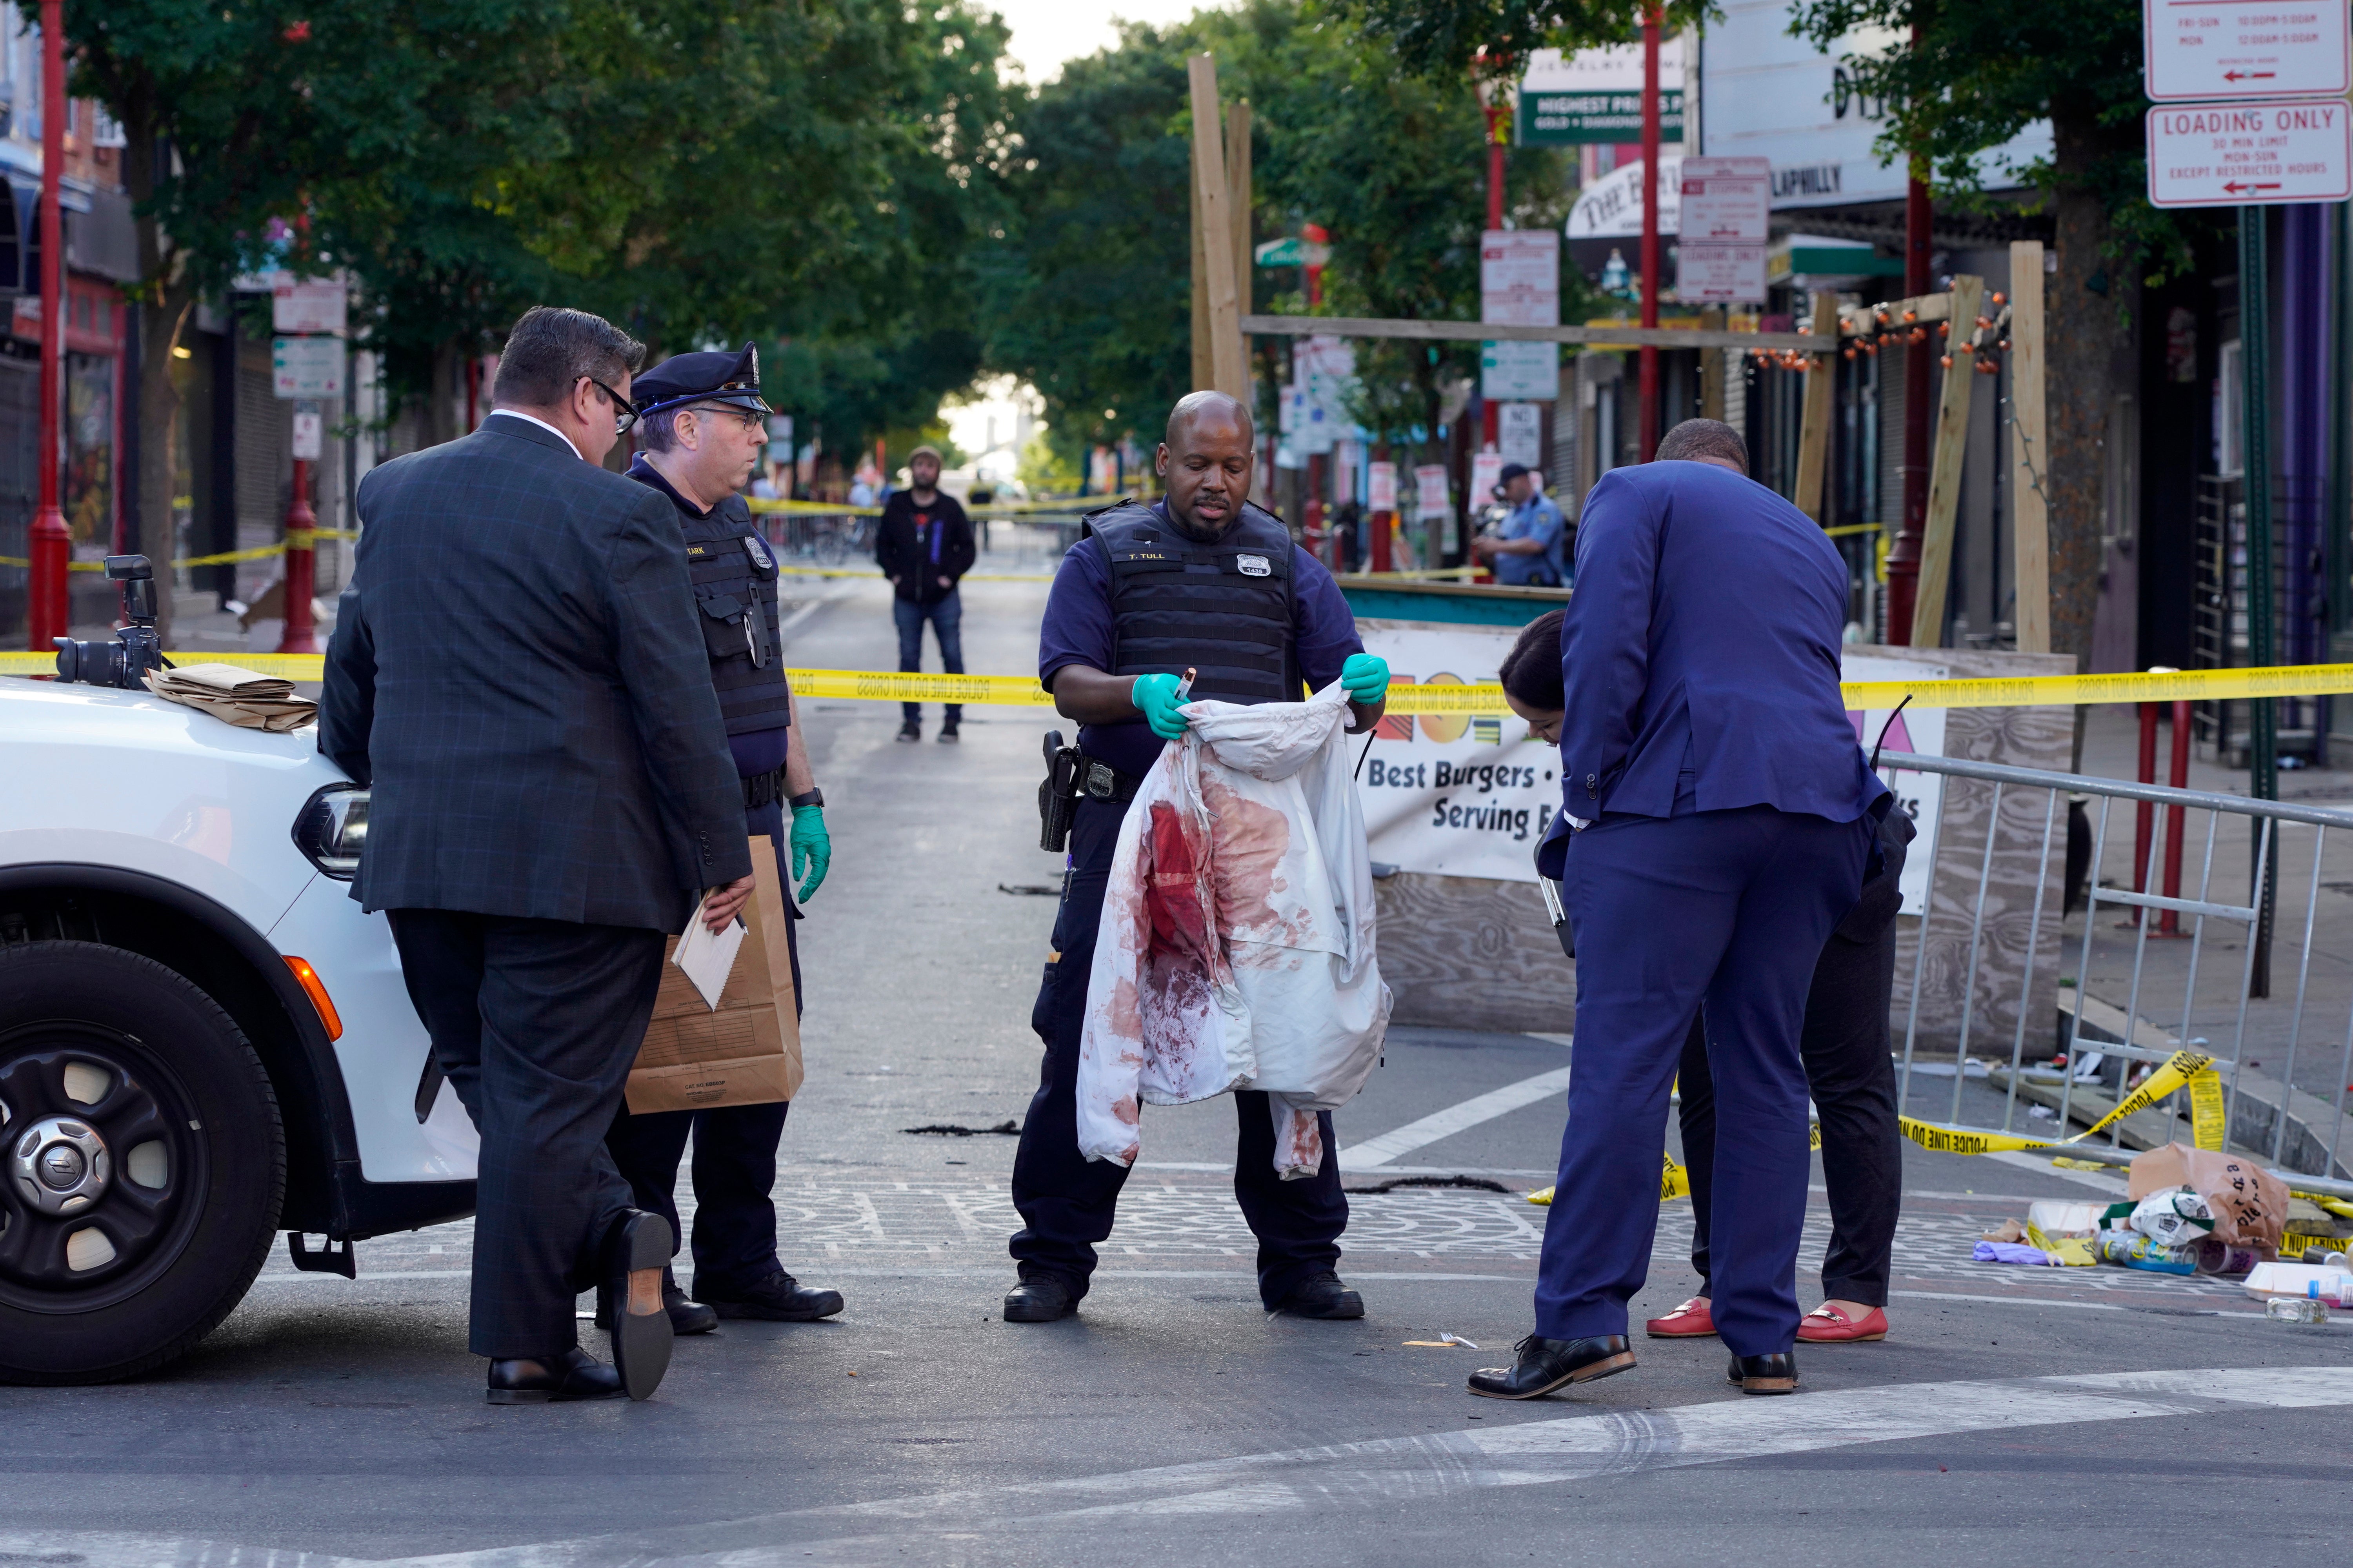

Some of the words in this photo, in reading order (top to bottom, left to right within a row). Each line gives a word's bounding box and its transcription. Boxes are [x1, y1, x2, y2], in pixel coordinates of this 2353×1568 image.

[2179, 35, 2204, 46] MON
[1537, 97, 1609, 113] HIGHEST
[1611, 96, 1670, 113] PRIS
[2164, 111, 2263, 135] LOADING
[2277, 108, 2334, 131] ONLY
[2212, 138, 2226, 149] 30
[2232, 137, 2254, 148] MIN
[2259, 135, 2288, 147] LIMIT
[2169, 166, 2210, 180] EXCEPT
[2216, 164, 2283, 177] RESTRICTED
[2288, 162, 2327, 174] HOURS
[1369, 759, 1426, 788] Best
[1435, 760, 1535, 793] Burgers
[1433, 797, 1530, 841] Serving
[1912, 1125, 1926, 1146] DO
[1929, 1129, 1950, 1150] LINE
[1954, 1136, 1988, 1153] POLICE
